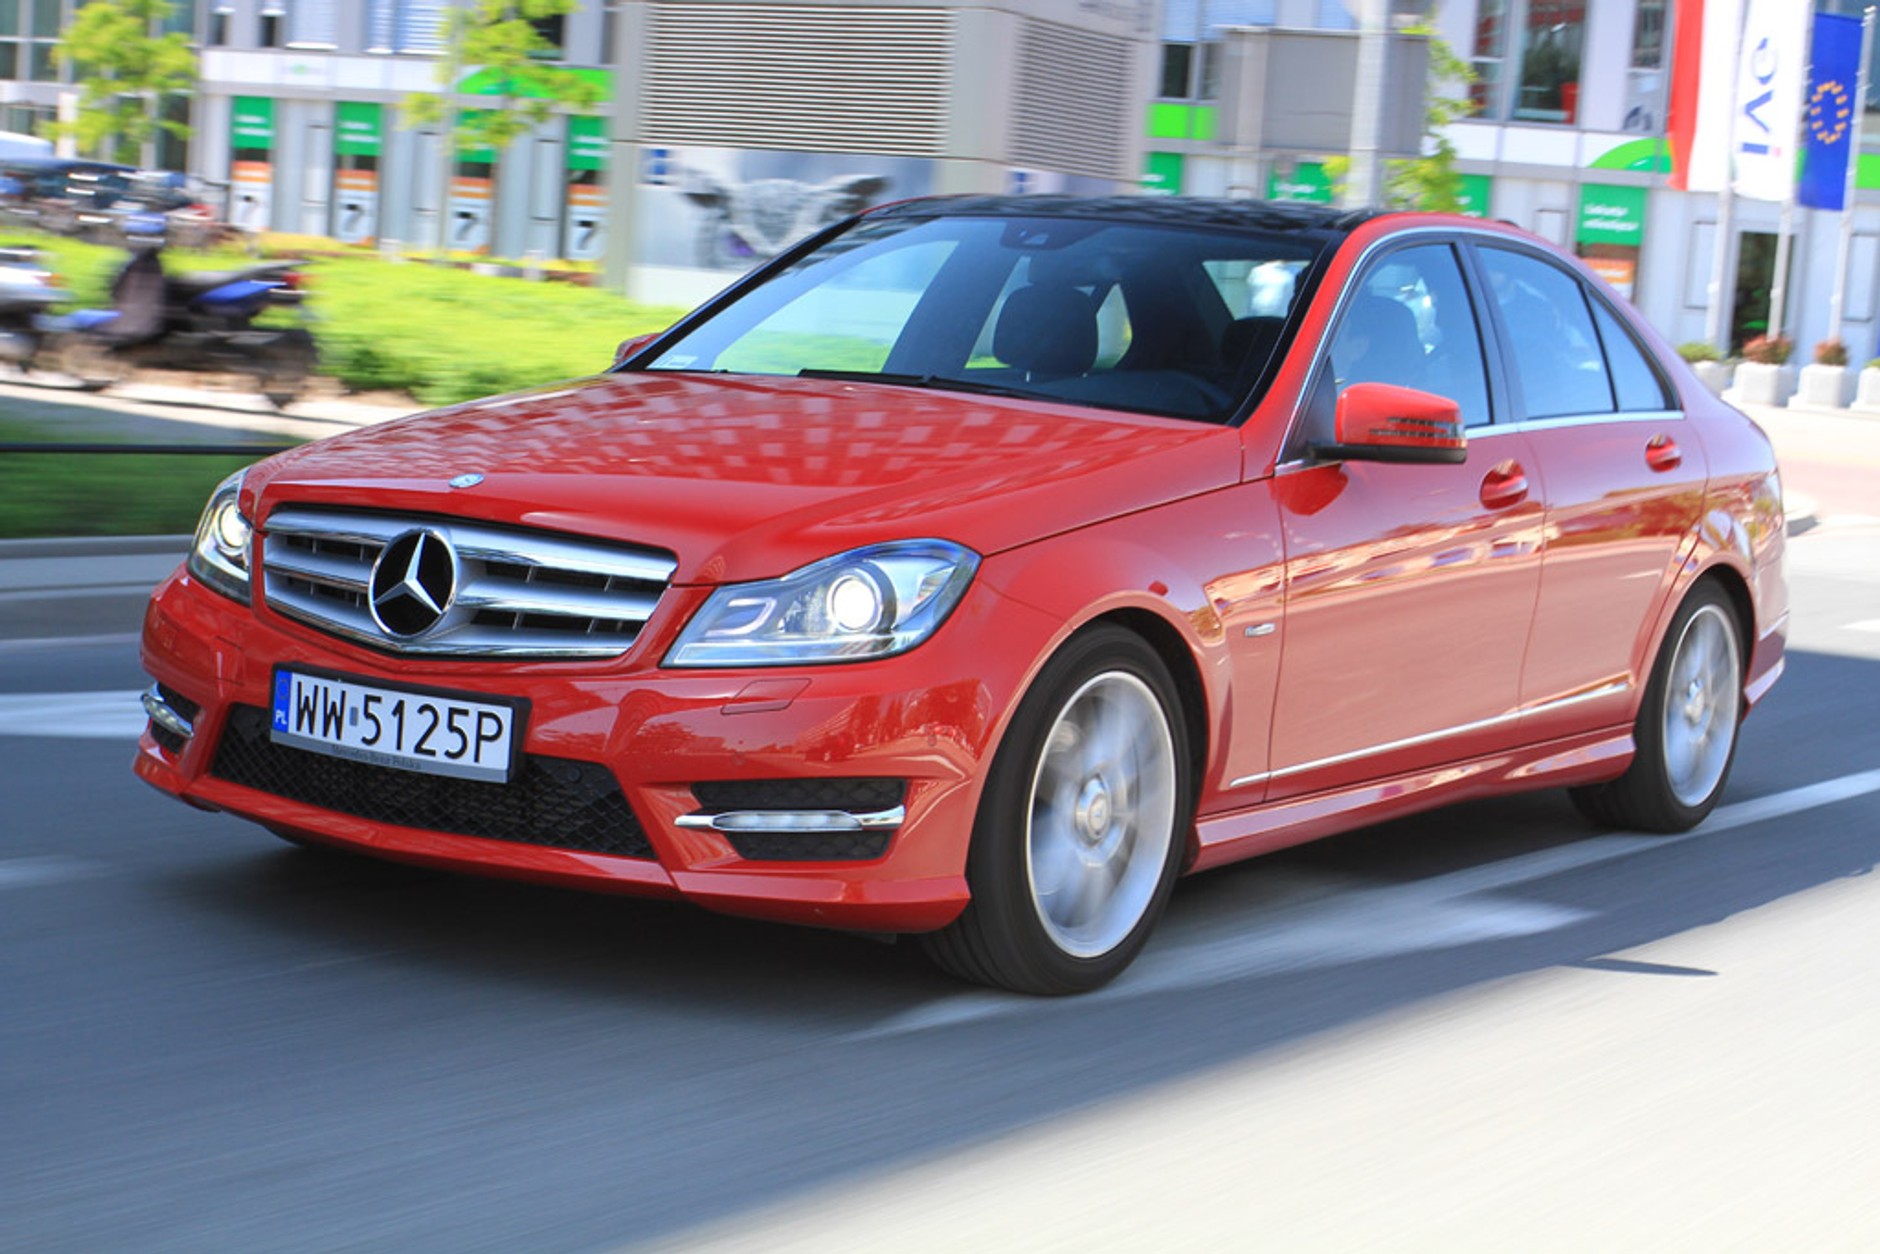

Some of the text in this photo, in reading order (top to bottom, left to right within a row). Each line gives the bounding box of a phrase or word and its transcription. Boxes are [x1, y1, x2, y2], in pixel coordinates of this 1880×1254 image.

[275, 709, 287, 725] PL
[296, 681, 504, 763] WW 5125P
